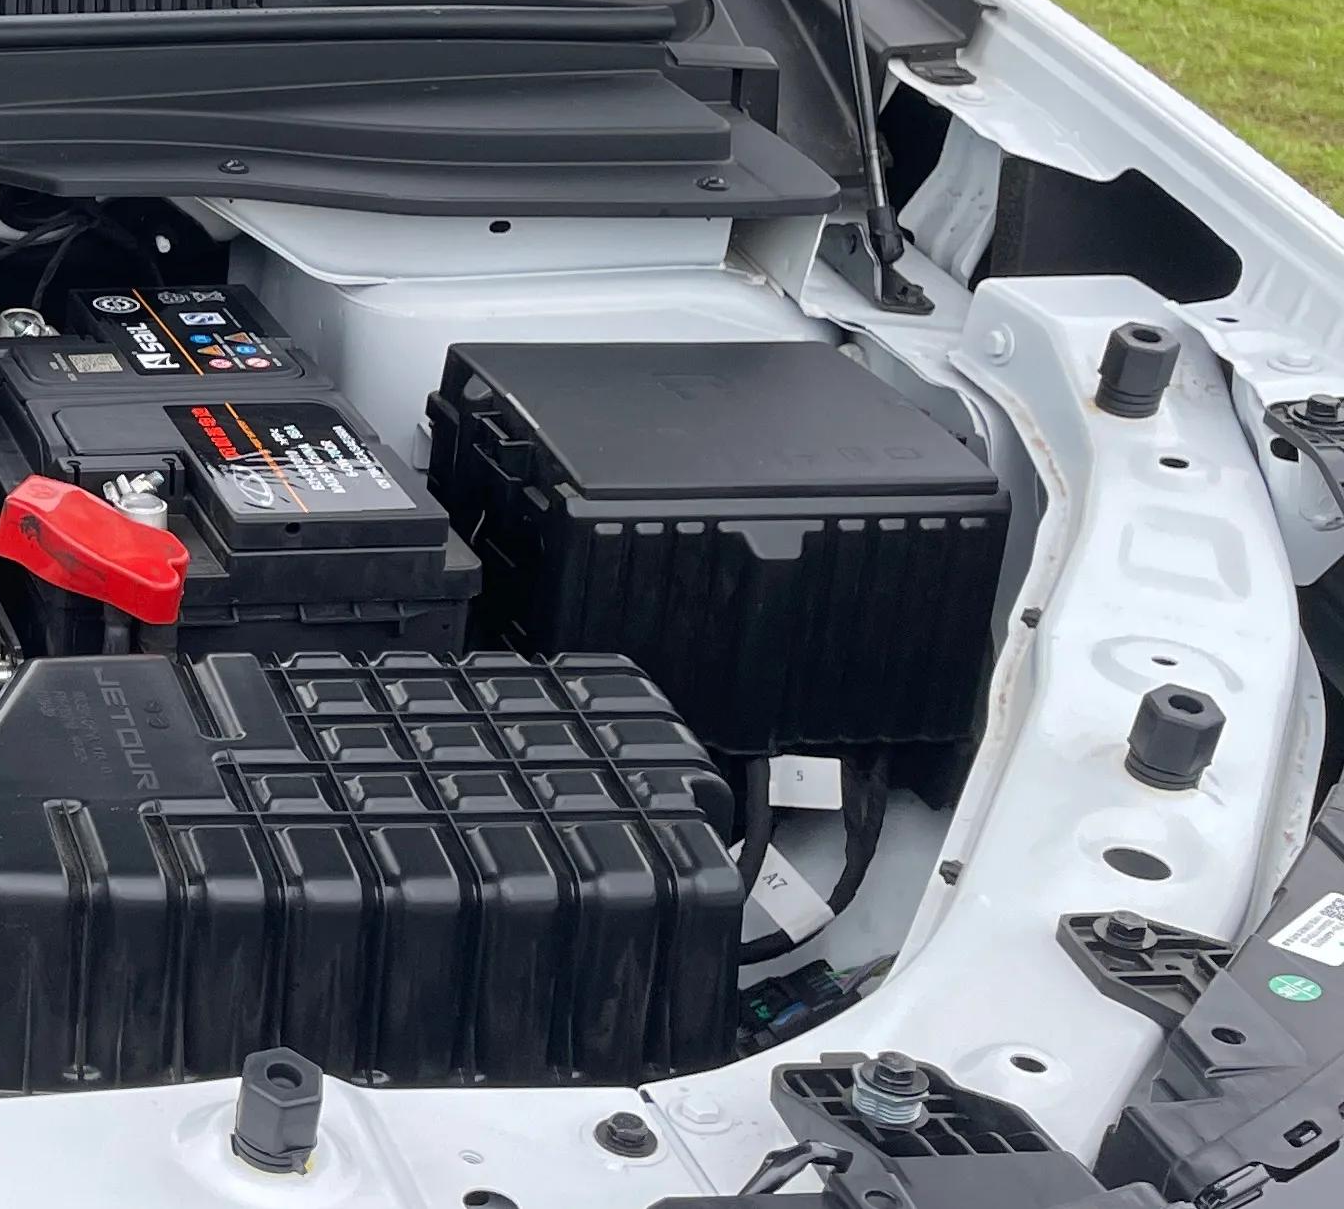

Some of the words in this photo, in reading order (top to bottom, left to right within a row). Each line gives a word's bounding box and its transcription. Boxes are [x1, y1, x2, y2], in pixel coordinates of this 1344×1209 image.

[93, 666, 161, 790] JETOUR
[796, 770, 804, 782] 5
[762, 872, 788, 890] A7
